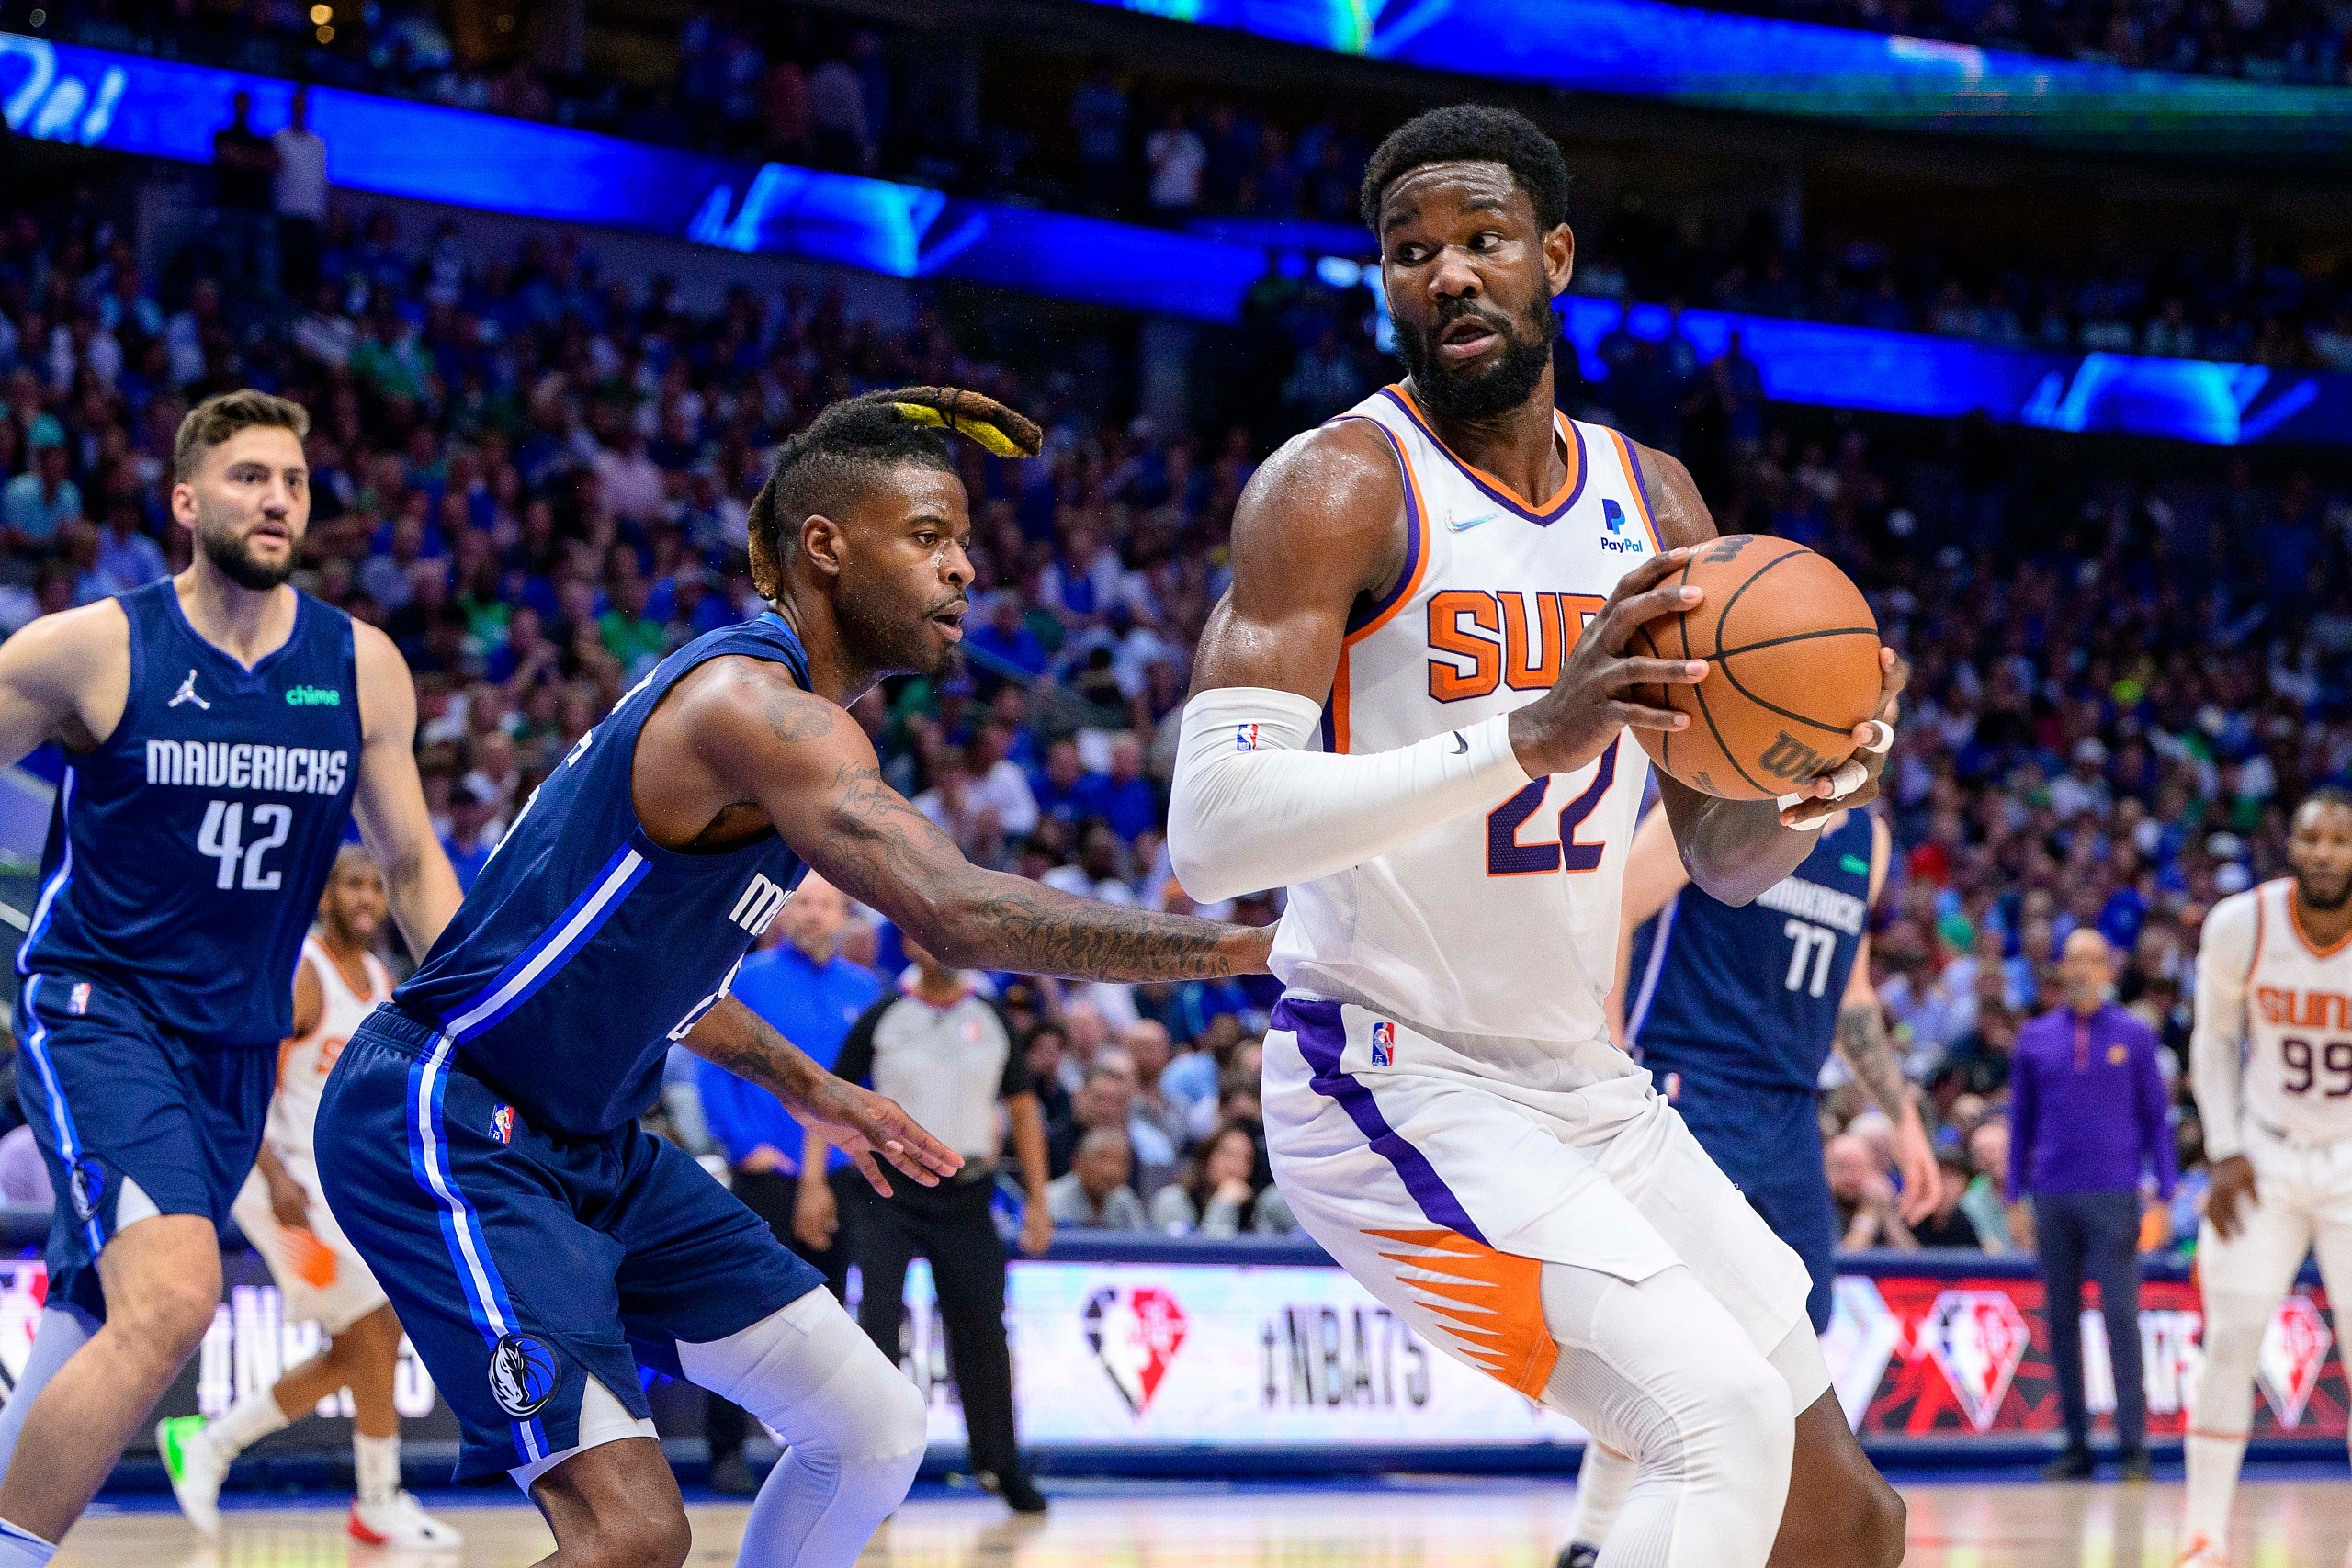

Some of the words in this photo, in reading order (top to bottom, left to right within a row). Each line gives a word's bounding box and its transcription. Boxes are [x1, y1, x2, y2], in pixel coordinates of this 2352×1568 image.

[1600, 536, 1643, 553] PayPal
[286, 684, 341, 706] chime
[146, 739, 348, 795] MAVERICKS
[197, 800, 293, 890] 42
[1784, 919, 1837, 998] 77
[2256, 986, 2352, 1032] SUN
[2282, 1035, 2352, 1099] 99
[1260, 1305, 1430, 1407] #NBA75
